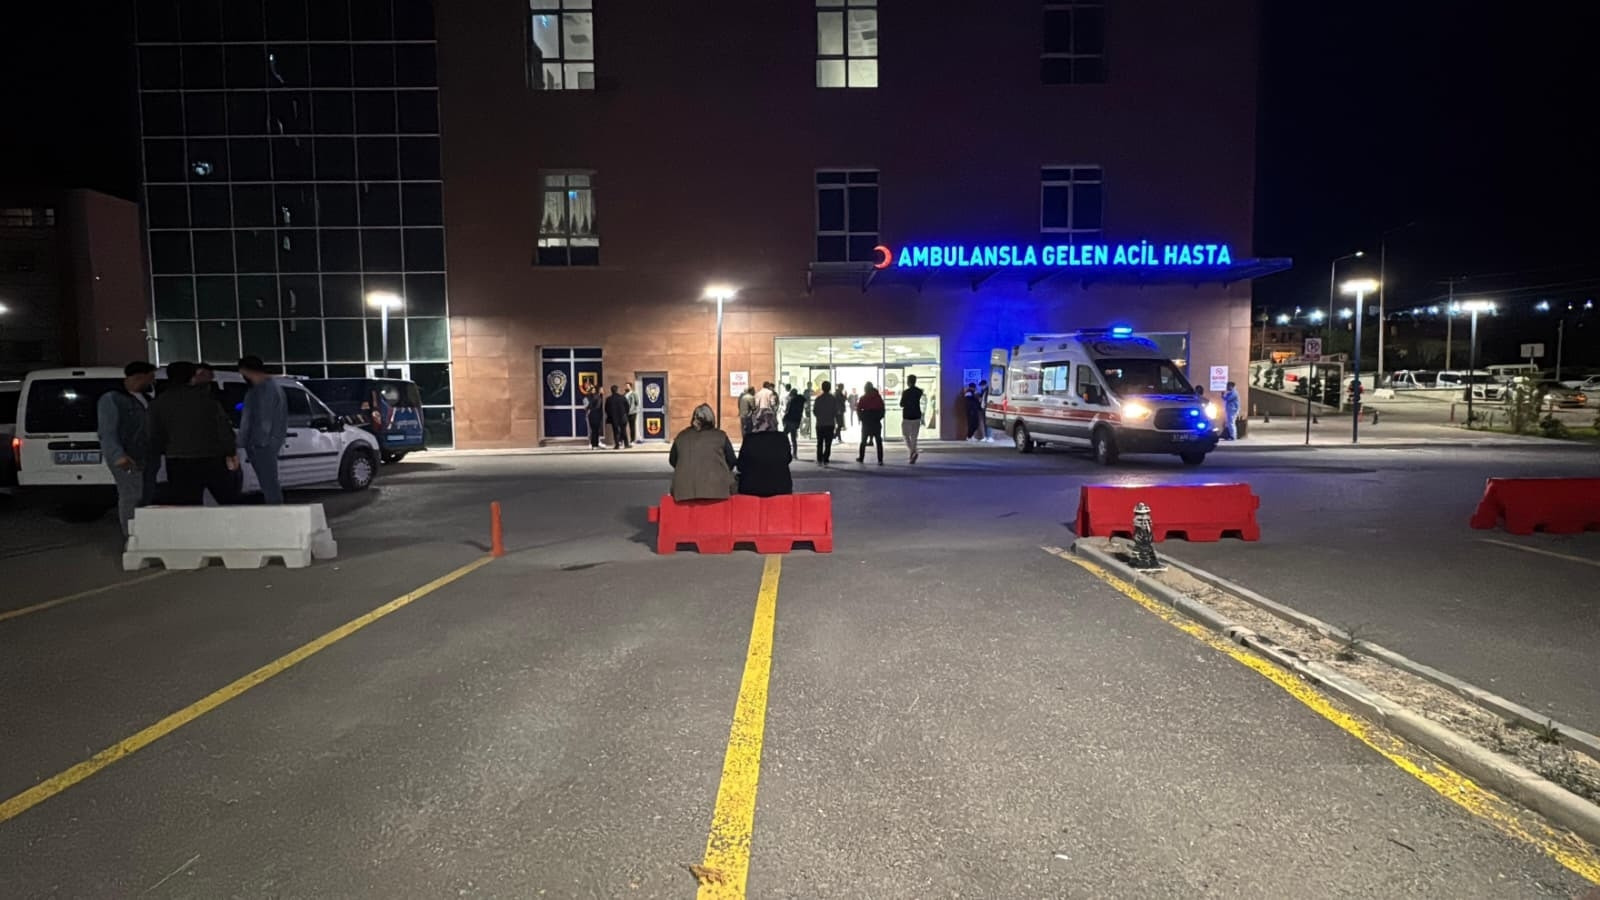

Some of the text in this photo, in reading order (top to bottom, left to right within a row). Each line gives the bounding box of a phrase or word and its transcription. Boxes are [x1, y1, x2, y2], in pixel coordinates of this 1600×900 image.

[897, 239, 1231, 267] AMBULANSLA GELEN ACİL HASTA
